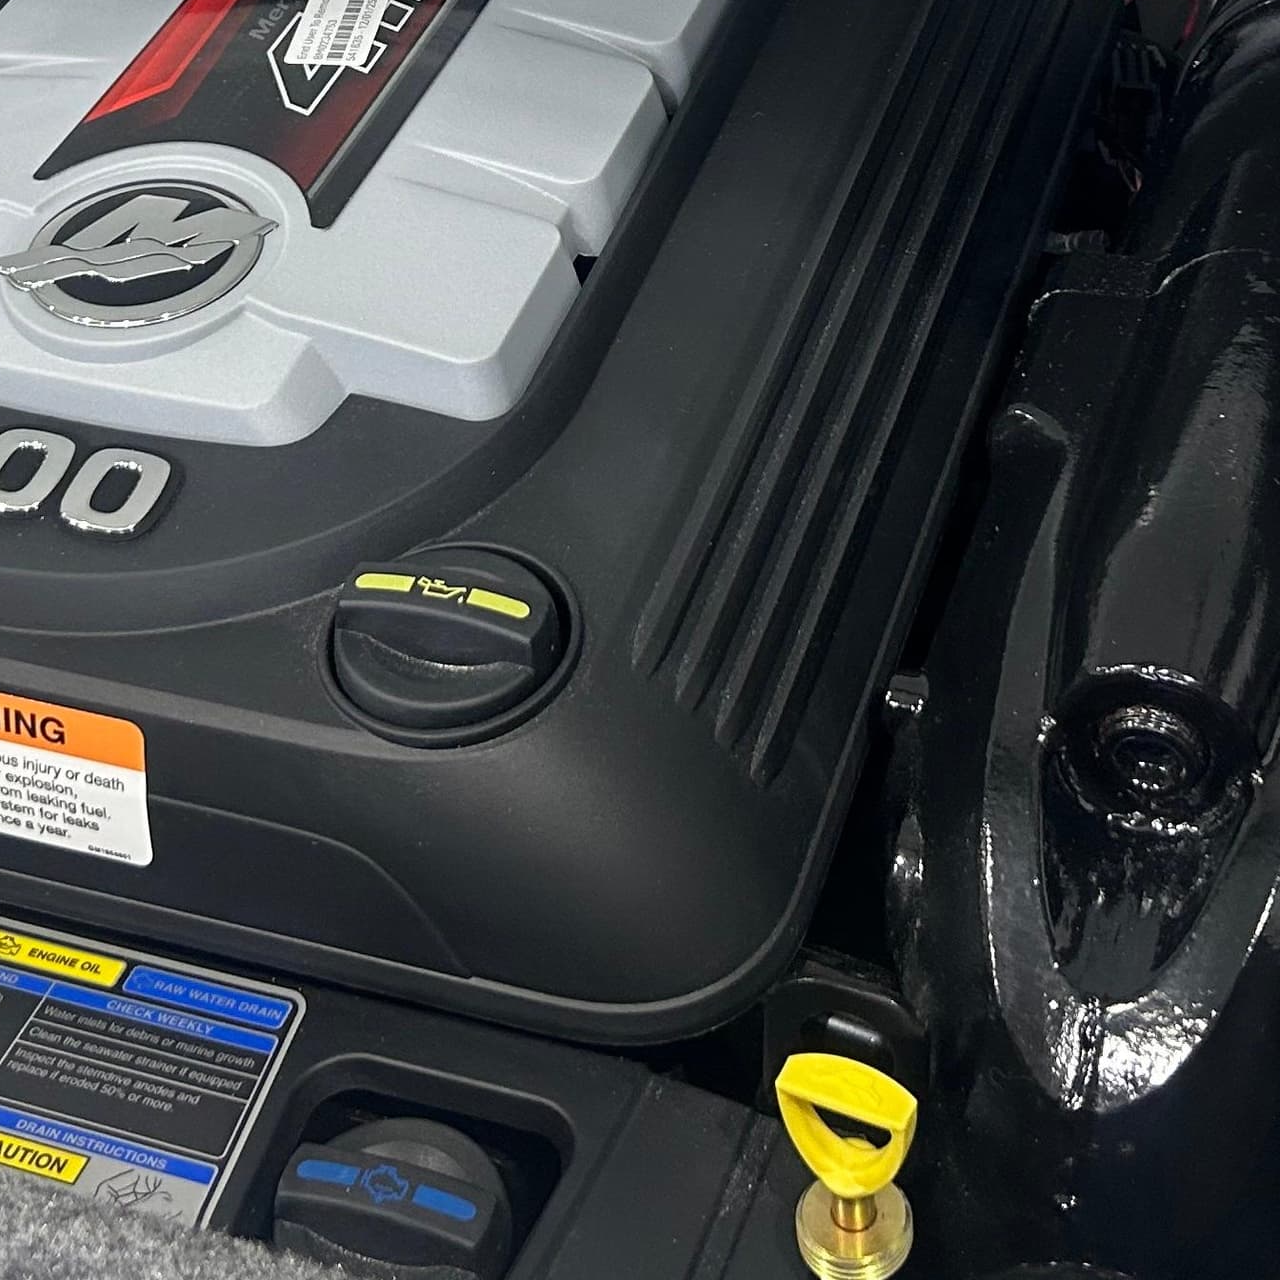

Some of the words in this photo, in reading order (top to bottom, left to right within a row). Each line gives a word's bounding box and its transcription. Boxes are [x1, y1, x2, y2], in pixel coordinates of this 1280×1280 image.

[296, 45, 310, 60] End
[304, 27, 318, 45] User
[311, 18, 322, 28] To
[4, 772, 77, 798] explosion,
[22, 757, 61, 779] injury
[65, 769, 80, 780] or
[83, 772, 124, 791] death
[26, 790, 76, 814] leaking
[80, 802, 110, 819] fuel,
[39, 806, 58, 821] for
[62, 812, 99, 831] leaks
[25, 820, 34, 829] a
[37, 823, 70, 837] year.
[27, 947, 79, 967] ENGINE
[80, 961, 100, 974] OIL
[106, 1000, 153, 1019] CHECK
[157, 1012, 212, 1033] WEEKLY
[154, 980, 186, 994] RAW
[189, 989, 236, 1008] WATER
[238, 1001, 281, 1020] DRAIN
[44, 1005, 76, 1020] Water
[77, 1016, 107, 1030] inlets
[108, 1021, 124, 1033] for
[125, 1028, 159, 1043] debris
[160, 1038, 175, 1046] or
[175, 1041, 214, 1057] marine
[214, 1052, 254, 1068] growth
[14, 1047, 56, 1065] Inspect
[56, 1058, 75, 1070] the
[76, 1065, 131, 1086] sterndrive
[132, 1080, 175, 1098] anodes
[176, 1092, 200, 1104] and
[28, 1026, 61, 1042] Clean
[62, 1036, 81, 1048] the
[82, 1042, 133, 1061] seawater
[134, 1056, 177, 1073] strainer
[178, 1066, 189, 1076] if
[188, 1070, 242, 1090] equipped
[6, 1059, 48, 1077] replace
[48, 1070, 60, 1079] if
[58, 1074, 100, 1090] eroded
[99, 1083, 125, 1098] 50%
[127, 1092, 141, 1102] or
[141, 1096, 172, 1111] more.
[15, 1119, 60, 1139] DRAIN
[62, 1133, 166, 1169] INSTRUCTIONS
